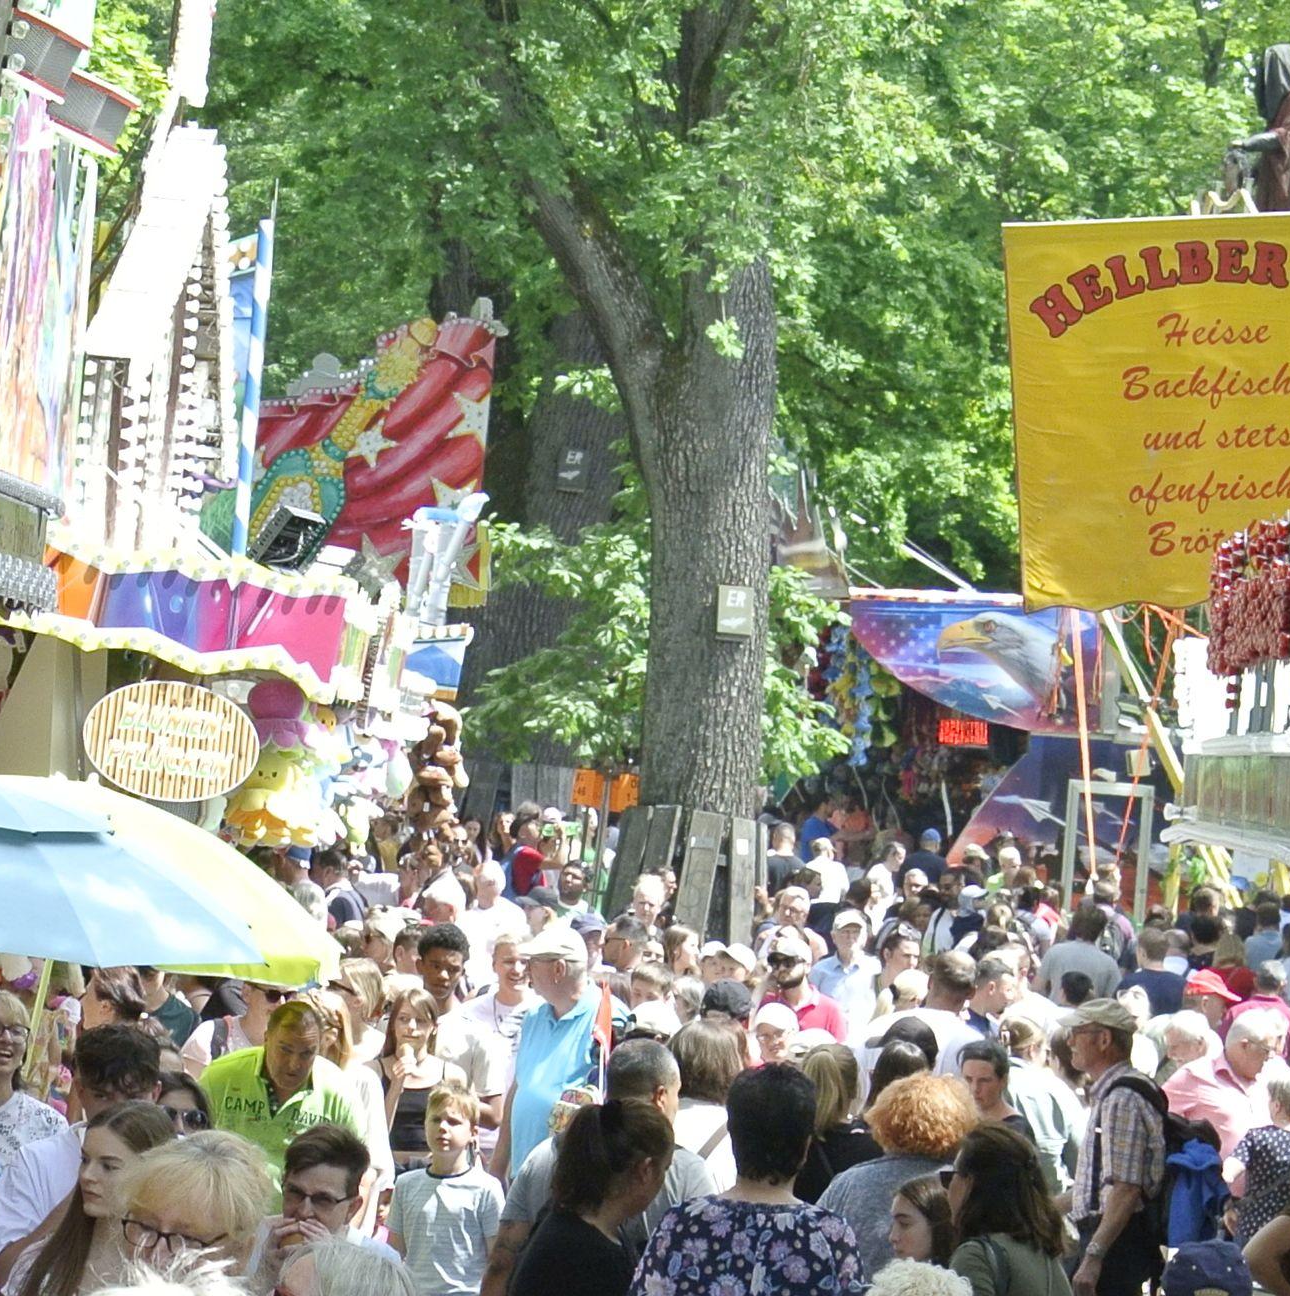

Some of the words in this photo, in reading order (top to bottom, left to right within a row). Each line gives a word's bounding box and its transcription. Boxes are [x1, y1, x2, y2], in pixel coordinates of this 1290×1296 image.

[1157, 313, 1272, 347] Heisse
[1143, 421, 1207, 451] und
[1147, 519, 1255, 557] Bröt
[224, 1096, 266, 1114] CAMP
